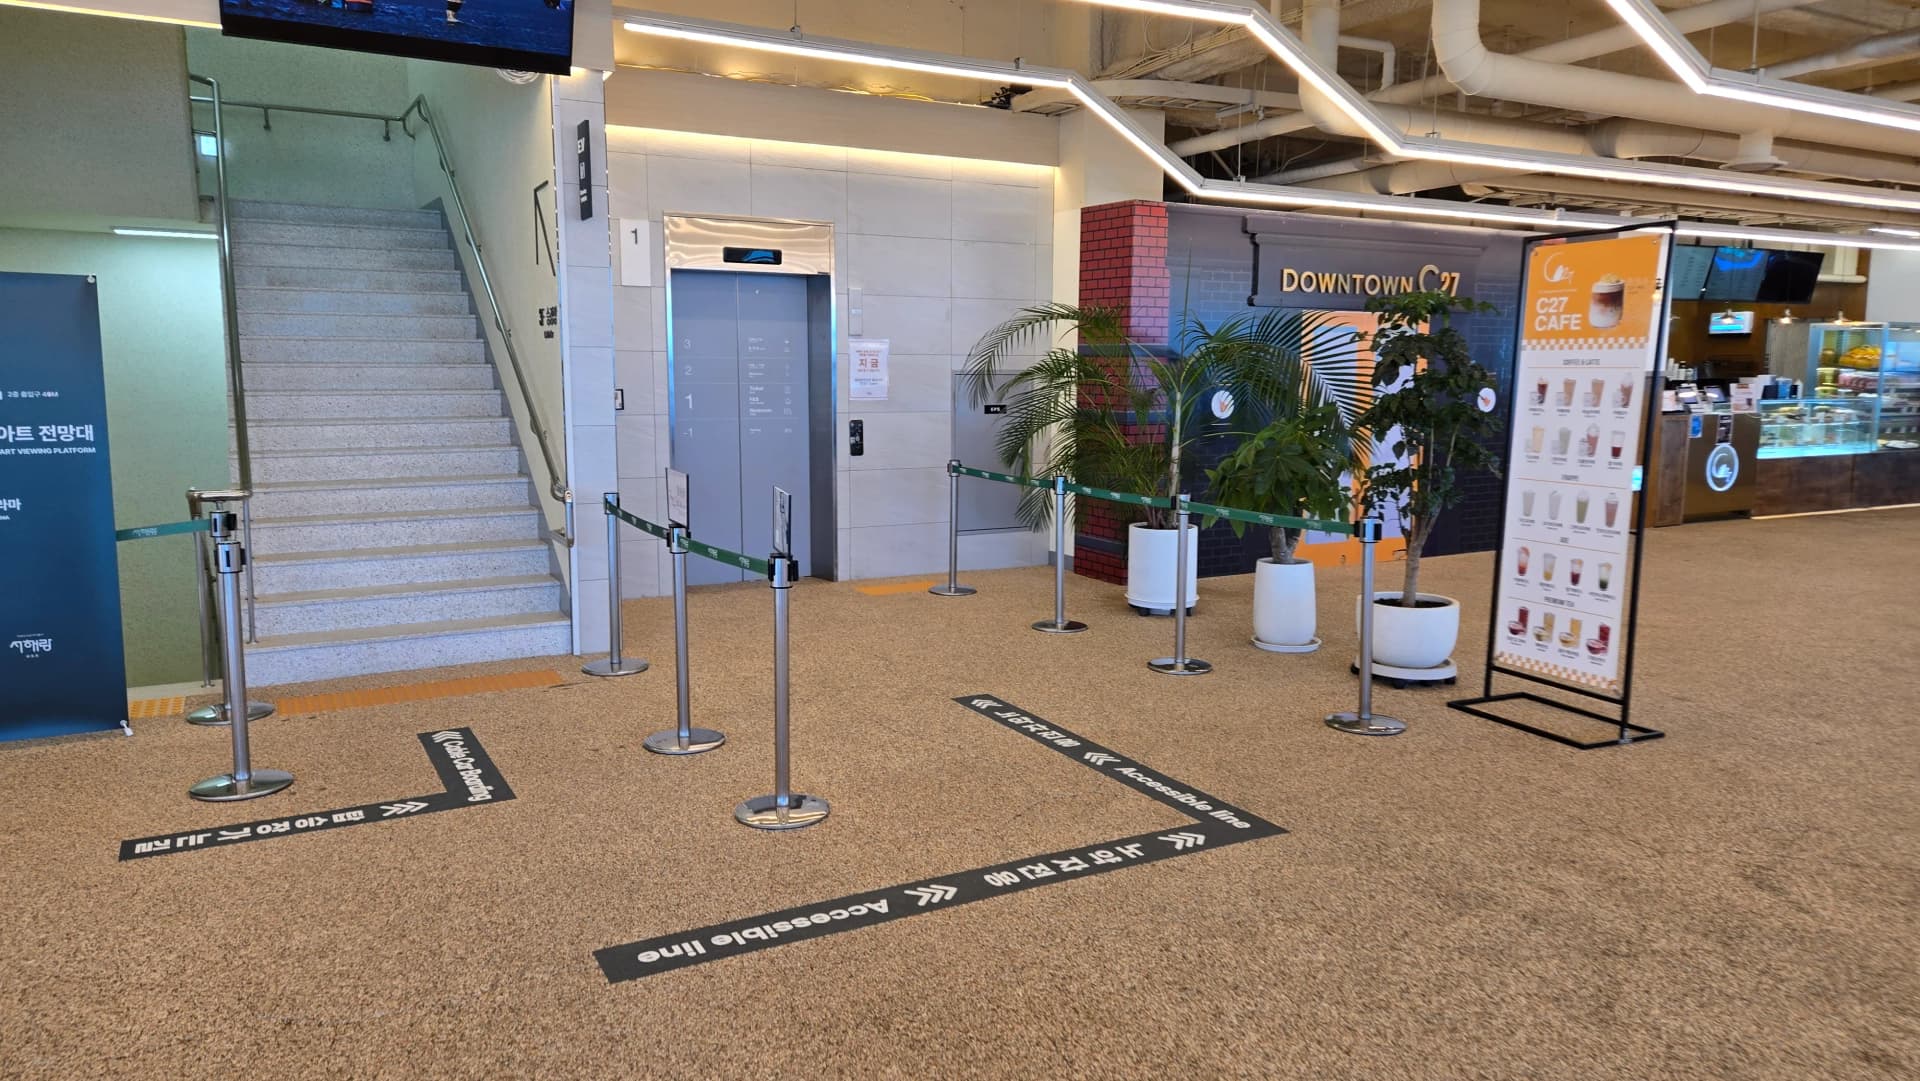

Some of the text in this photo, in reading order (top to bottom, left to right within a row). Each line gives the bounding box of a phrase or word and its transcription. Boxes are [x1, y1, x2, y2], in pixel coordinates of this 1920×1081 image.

[631, 228, 638, 245] 1
[1281, 264, 1461, 298] DOWNTOWN C27
[1535, 296, 1568, 314] C27
[1534, 313, 1583, 332] CAFE
[684, 338, 692, 350] 3
[684, 365, 694, 376] 2
[685, 393, 693, 409] 1
[38, 424, 95, 442] 전망대
[0, 446, 97, 456] ART VIEWING PLATFORM
[442, 740, 494, 802] Cable Car Boarding
[1114, 766, 1252, 830] Accessible line
[636, 898, 890, 964] Accessible line
